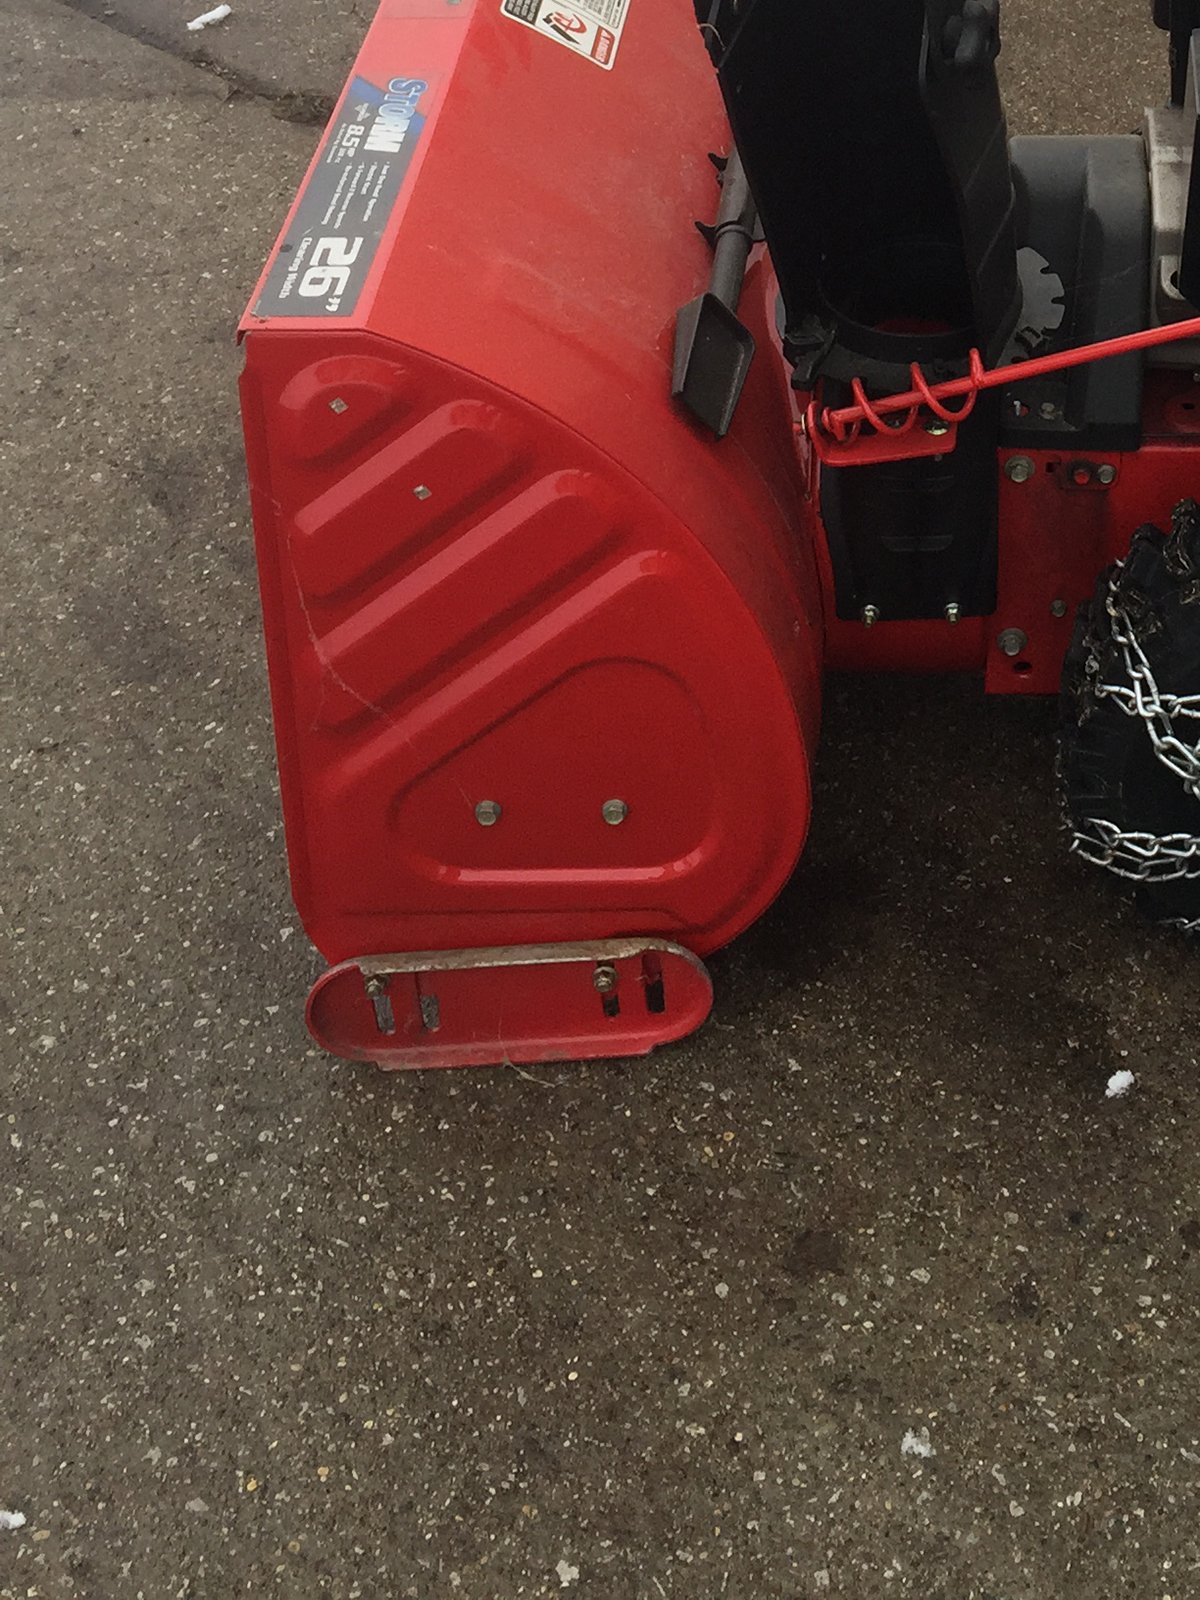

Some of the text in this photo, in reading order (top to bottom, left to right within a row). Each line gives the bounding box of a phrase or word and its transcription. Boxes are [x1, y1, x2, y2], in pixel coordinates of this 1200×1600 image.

[341, 123, 364, 147] 8.5
[364, 78, 427, 152] STORM
[277, 236, 312, 298] Clearing Width
